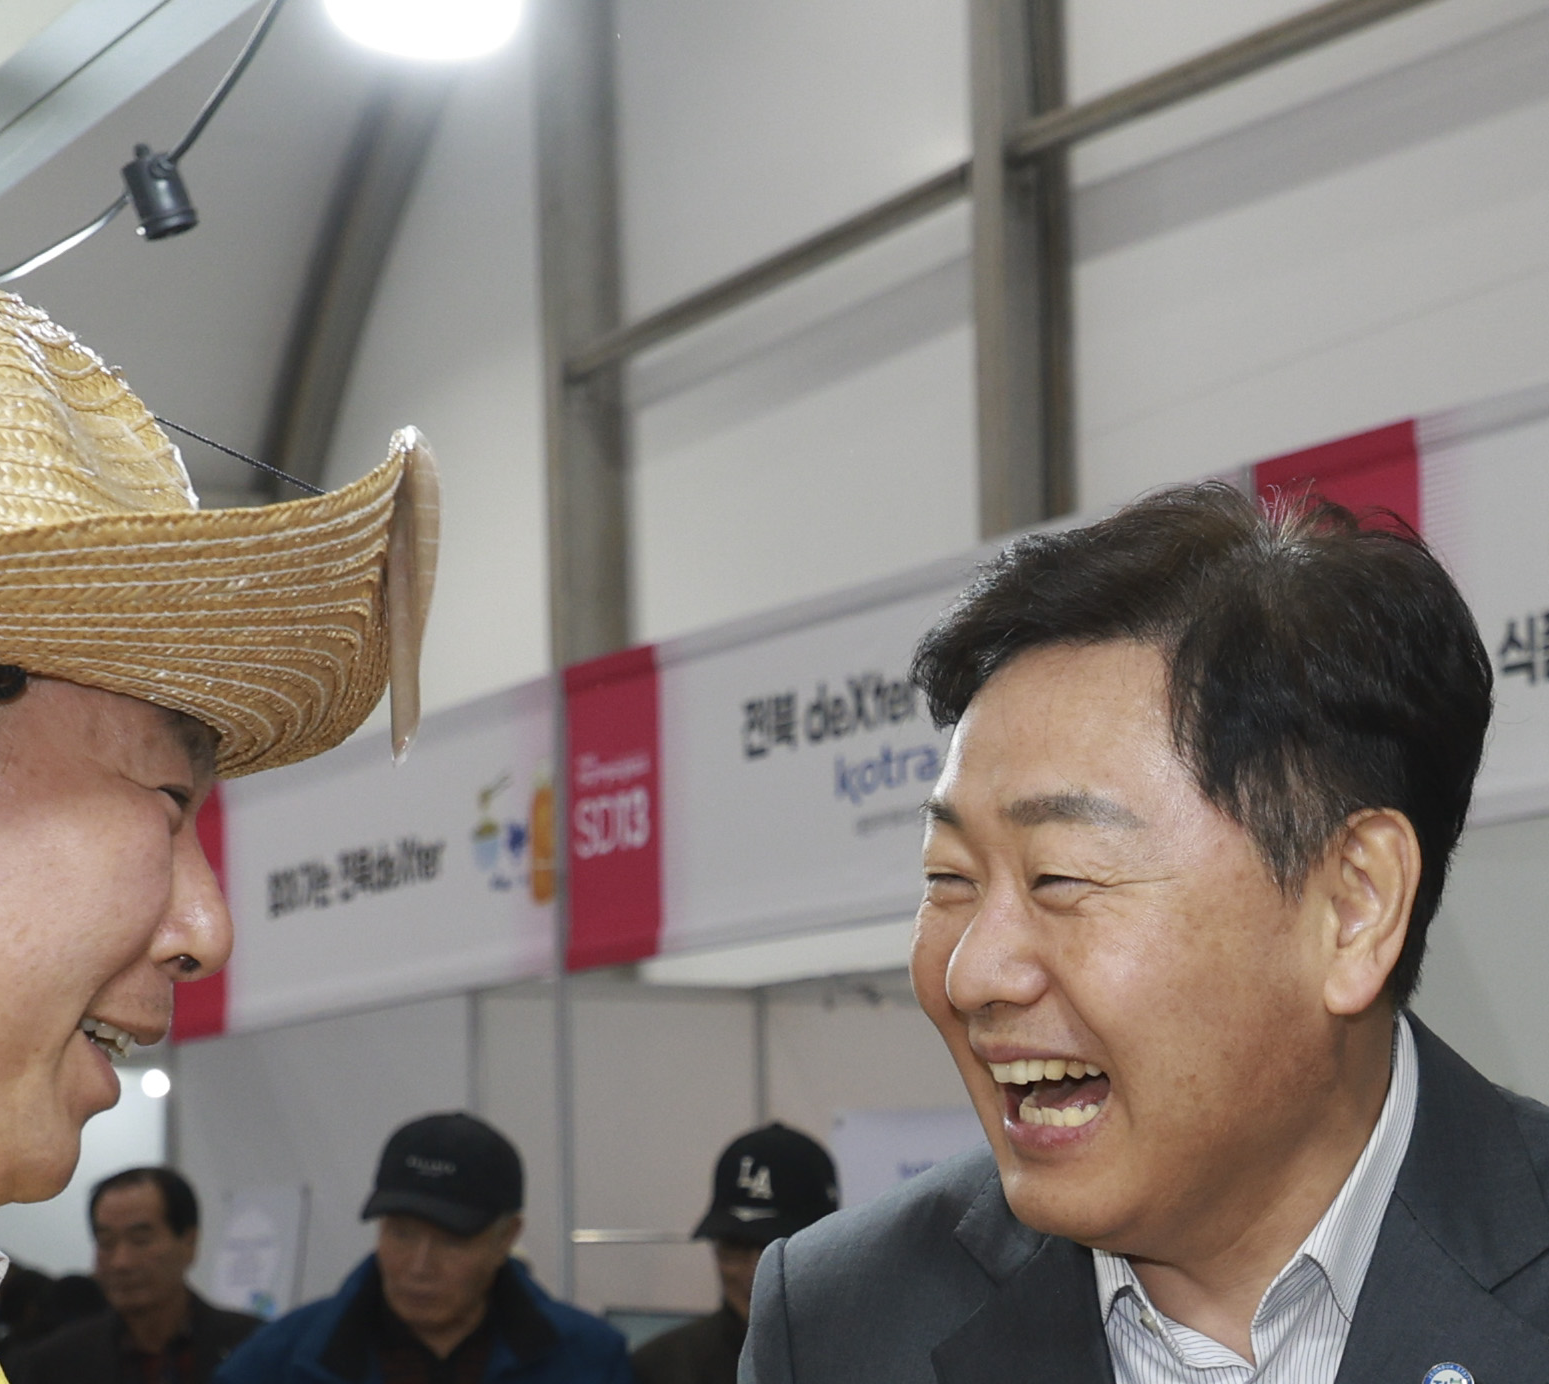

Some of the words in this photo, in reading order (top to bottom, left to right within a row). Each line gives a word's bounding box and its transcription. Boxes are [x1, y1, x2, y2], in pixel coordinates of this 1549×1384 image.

[834, 747, 939, 805] kotra
[574, 786, 650, 859] SD13
[737, 1156, 773, 1200] LA
